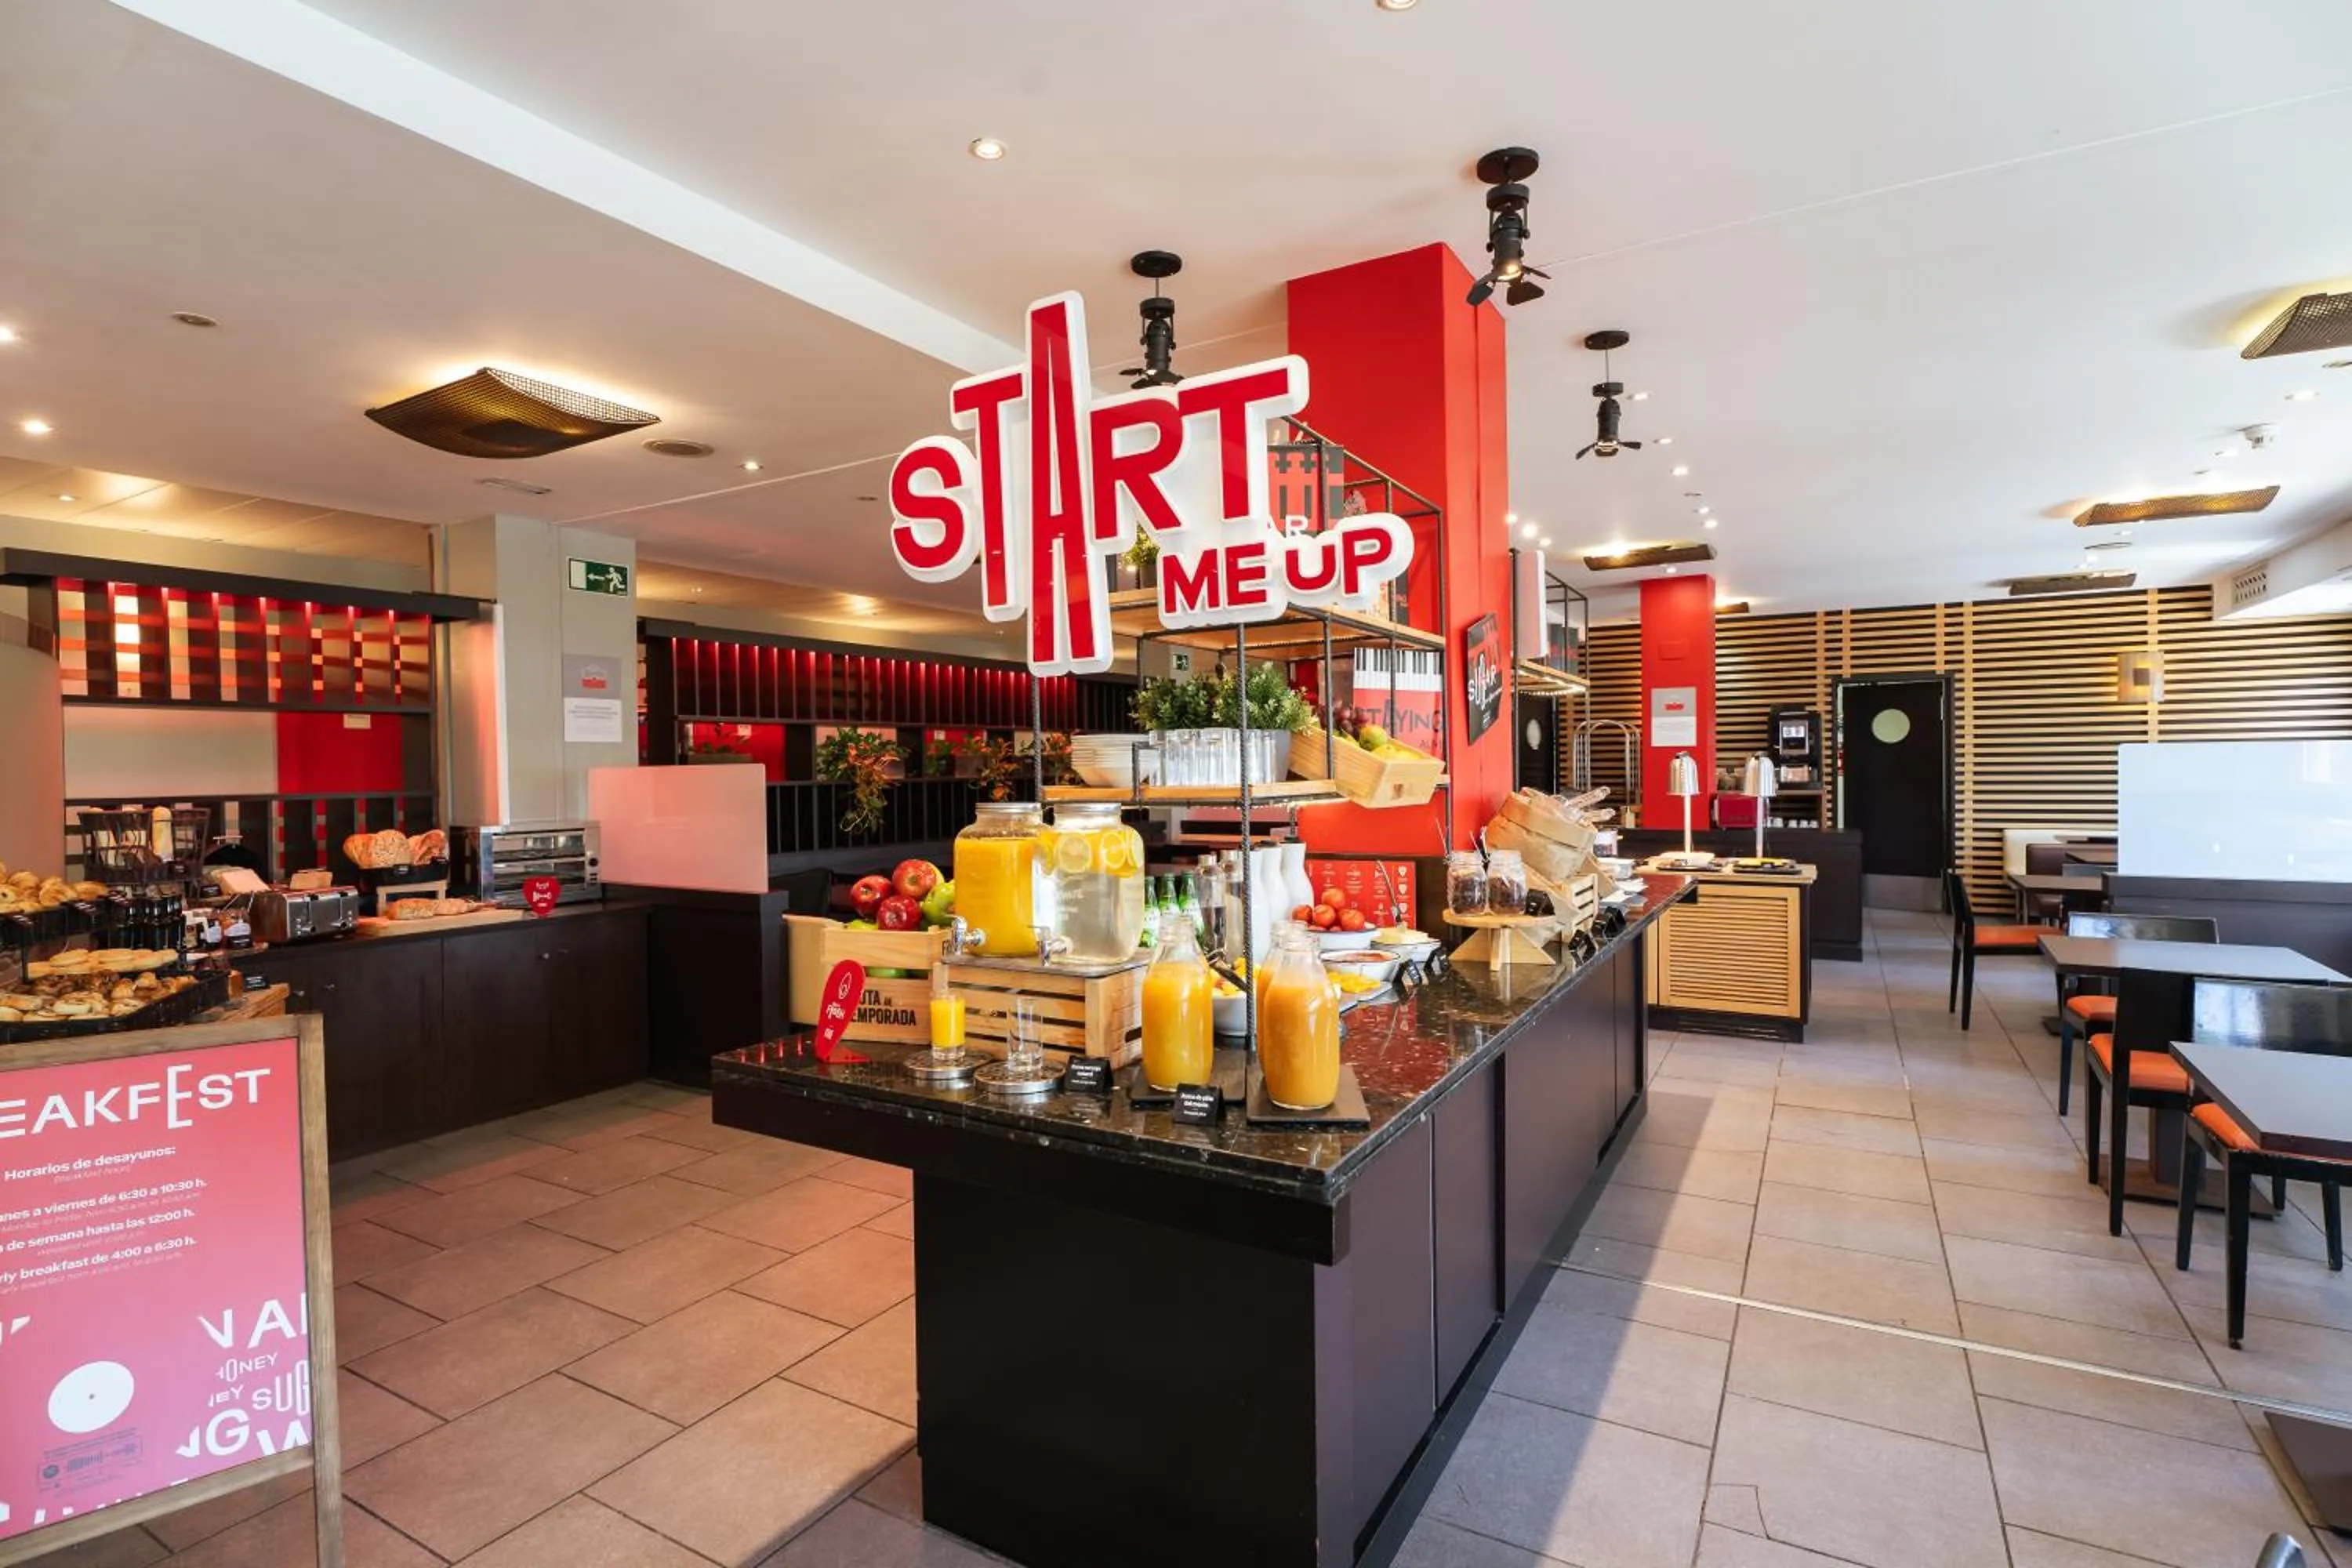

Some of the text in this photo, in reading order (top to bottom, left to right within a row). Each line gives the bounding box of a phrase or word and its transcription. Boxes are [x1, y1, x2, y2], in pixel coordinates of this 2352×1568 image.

[891, 302, 1289, 662] START
[1163, 528, 1392, 614] ME UP
[851, 1007, 916, 1026] EMPORADA
[4, 1163, 70, 1181] Horarios
[72, 1158, 92, 1171] de
[33, 1208, 42, 1217] a
[45, 1198, 96, 1214] viernes
[99, 1193, 116, 1205] de
[6, 1240, 26, 1252] de
[27, 1229, 84, 1247] semana
[86, 1221, 125, 1236] hasta
[20, 1257, 89, 1279] breakfast
